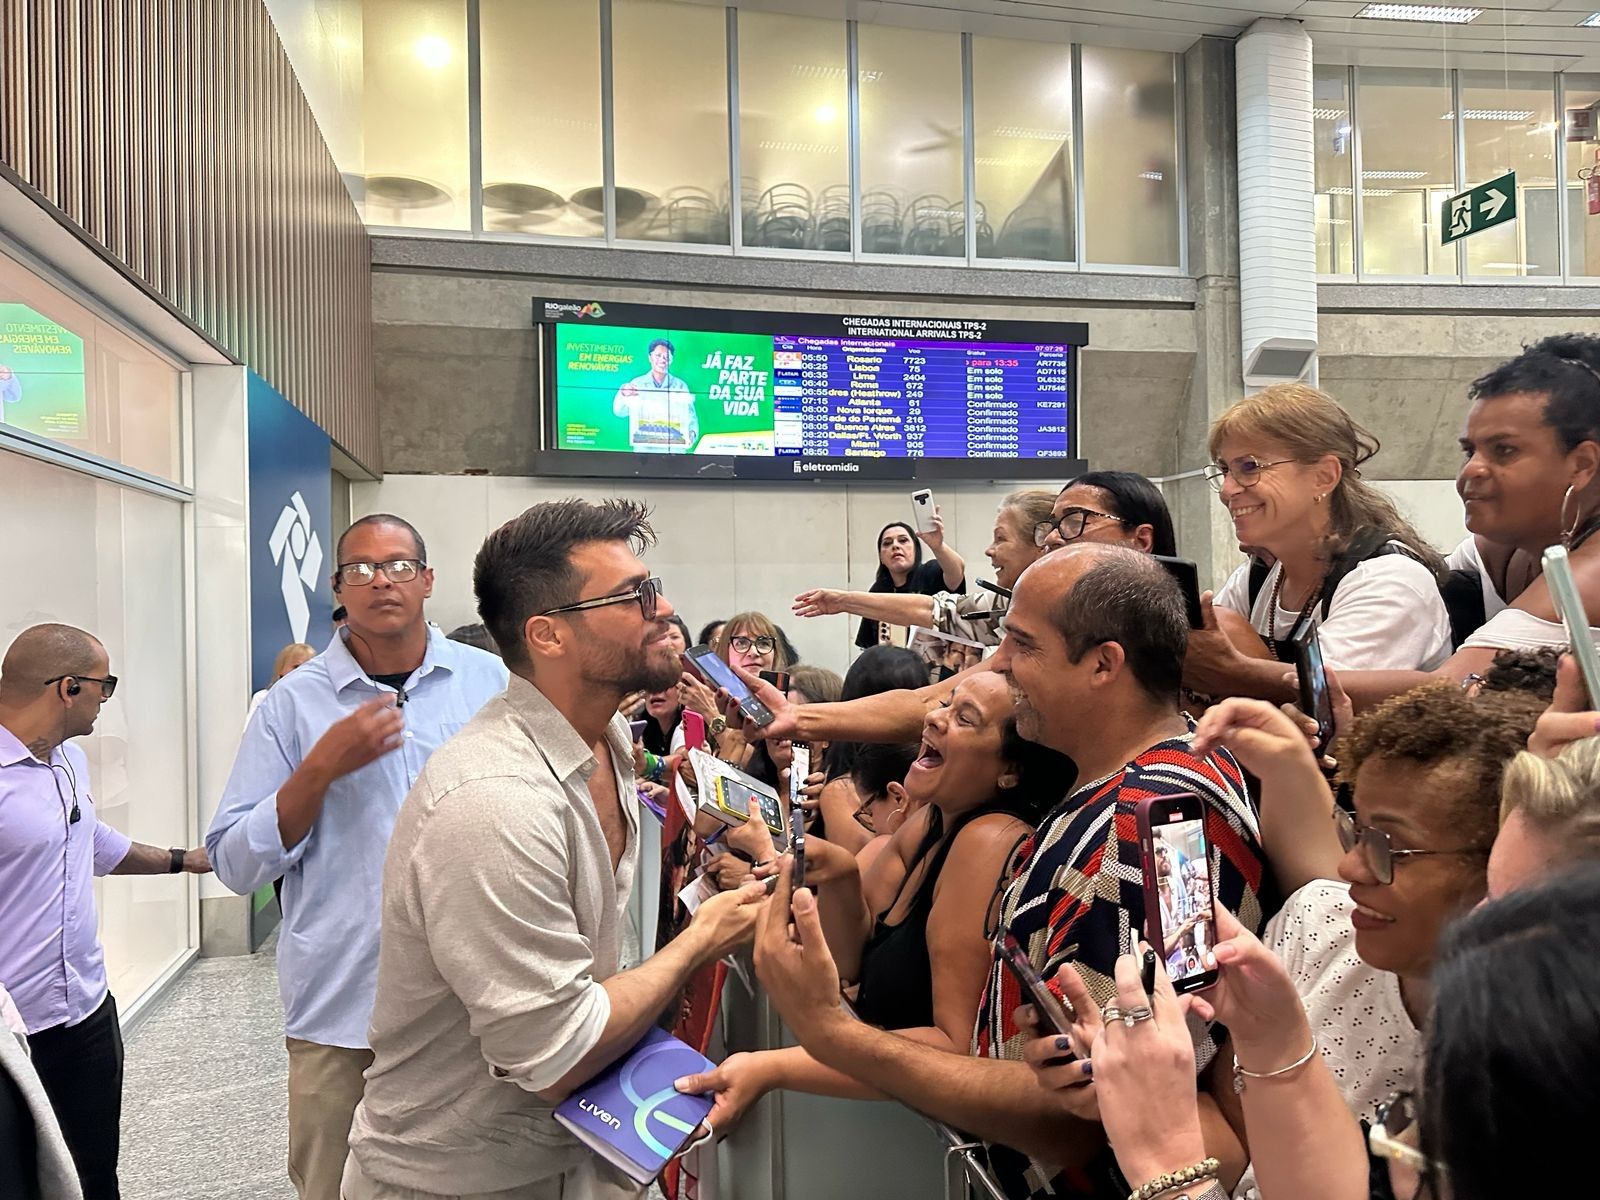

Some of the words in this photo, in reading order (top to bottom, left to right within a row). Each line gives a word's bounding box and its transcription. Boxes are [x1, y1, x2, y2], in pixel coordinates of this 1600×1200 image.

[842, 317, 891, 327] CHEGADAS
[892, 319, 961, 330] INTERNACIONAIS
[963, 322, 987, 331] TPS-2
[848, 327, 914, 337] INTERNATIONAL
[916, 329, 957, 338] ARRIVALS
[958, 331, 982, 340] TPS-2
[566, 342, 625, 354] INVESTIMENTO
[798, 337, 839, 346] Chegadas
[840, 339, 896, 348] Internacionais
[579, 353, 592, 362] EM
[593, 354, 633, 364] ENERGIAS
[702, 350, 722, 370] JÁ
[723, 354, 755, 371] FAZ
[802, 354, 828, 362] 05:50
[568, 360, 619, 373] RENOVÁVEIS
[850, 364, 880, 372] Lisboa
[718, 369, 768, 386] PARTE
[903, 374, 926, 382] 2404
[906, 382, 924, 390] 672
[708, 384, 731, 400] DA
[734, 386, 766, 401] SUA
[802, 388, 828, 396] 06:55
[851, 390, 902, 398] (Heathrow)
[984, 392, 1003, 400] solo
[723, 401, 760, 416] VIDA
[848, 398, 882, 406] Atlanta
[967, 400, 1018, 408] Confirmado
[836, 406, 861, 414] Nova
[863, 407, 893, 416] Iorque
[908, 408, 921, 416] 29
[967, 409, 1018, 417] Confirmado
[802, 414, 828, 422] 08:05
[862, 416, 902, 424] Panamá
[906, 416, 924, 424] 216
[967, 417, 1018, 425] Confirmado
[871, 424, 896, 432] Aires
[874, 432, 902, 440] Worth
[906, 433, 924, 441] 937
[851, 440, 880, 448] Miami
[967, 442, 1018, 450] Confirmado
[802, 448, 828, 456] 08:50
[845, 449, 886, 458] Santiago
[967, 450, 1018, 458] Confirmado
[802, 461, 859, 472] eletromidia
